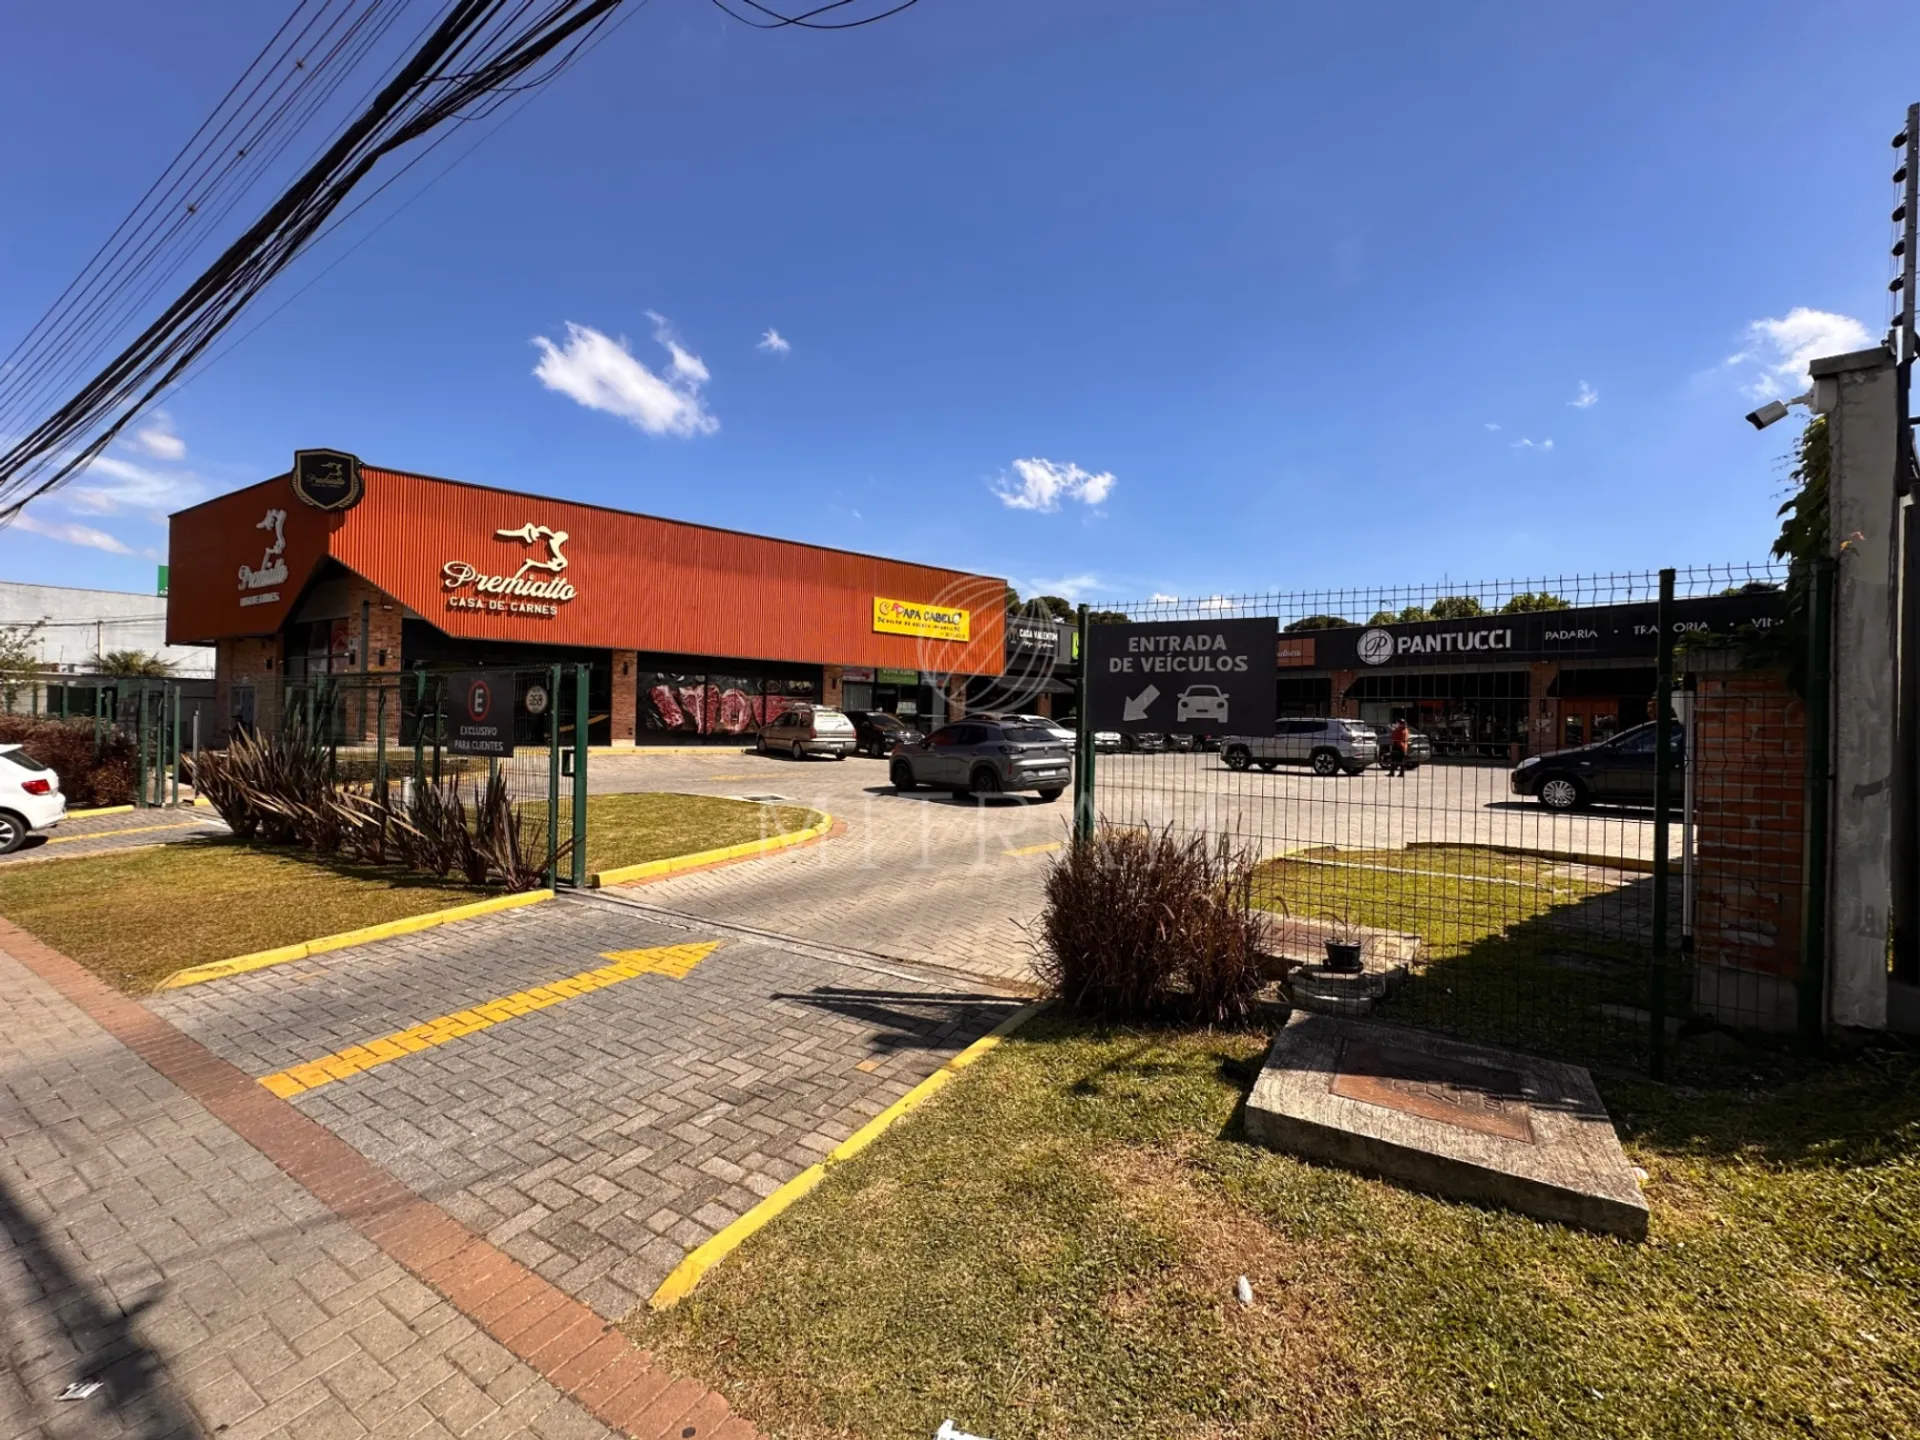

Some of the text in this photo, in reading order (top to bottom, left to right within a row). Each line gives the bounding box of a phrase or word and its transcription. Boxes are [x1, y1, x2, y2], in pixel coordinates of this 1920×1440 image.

[443, 560, 577, 600] Premiatto
[449, 596, 558, 615] CASA DE CARNES
[1128, 634, 1227, 653] ENTRADA
[1397, 628, 1512, 654] PANTUCCI
[1544, 629, 1598, 641] PADARIA
[1109, 653, 1249, 673] DE VEÍCULOS
[474, 688, 484, 713] E
[460, 725, 498, 736] EXCLUSIVO
[454, 739, 504, 752] PARA CLIENTES
